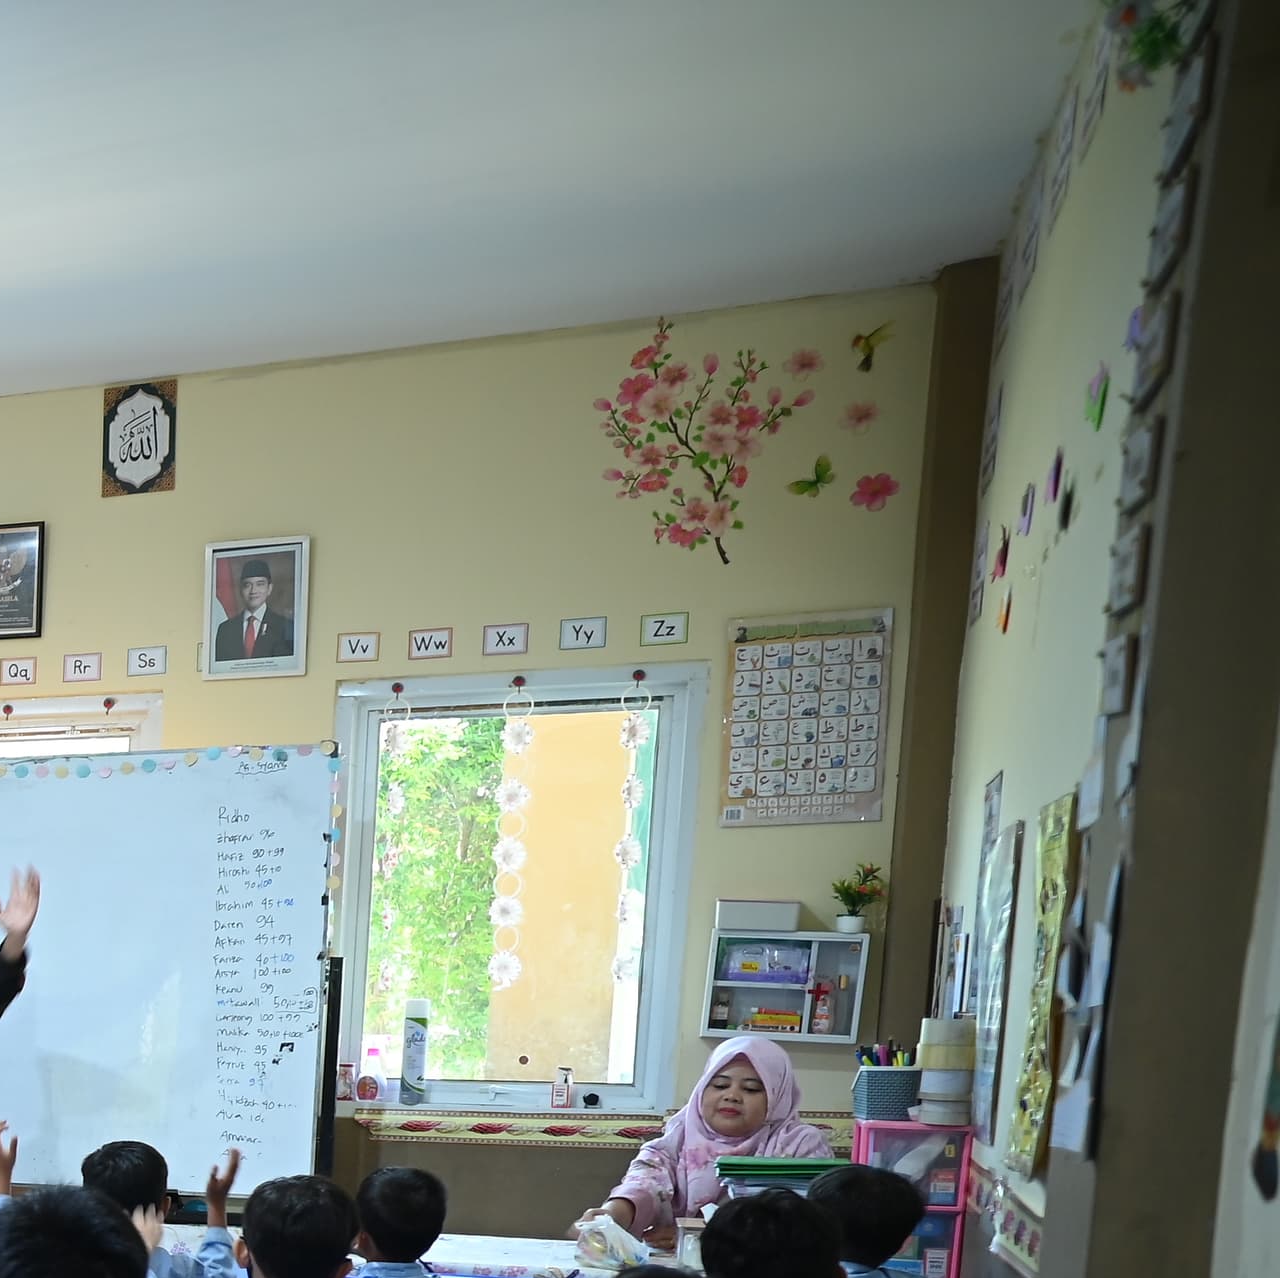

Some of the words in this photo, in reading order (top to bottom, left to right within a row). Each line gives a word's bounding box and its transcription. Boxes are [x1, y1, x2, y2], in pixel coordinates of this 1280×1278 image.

[572, 624, 594, 645] Yy
[652, 620, 676, 637] Zz
[348, 638, 369, 654] Vv
[413, 636, 447, 651] Ww
[495, 631, 516, 647] Xx
[73, 659, 91, 675] Rr
[137, 653, 156, 669] Ss
[8, 663, 30, 681] Qq
[255, 914, 276, 929] 94
